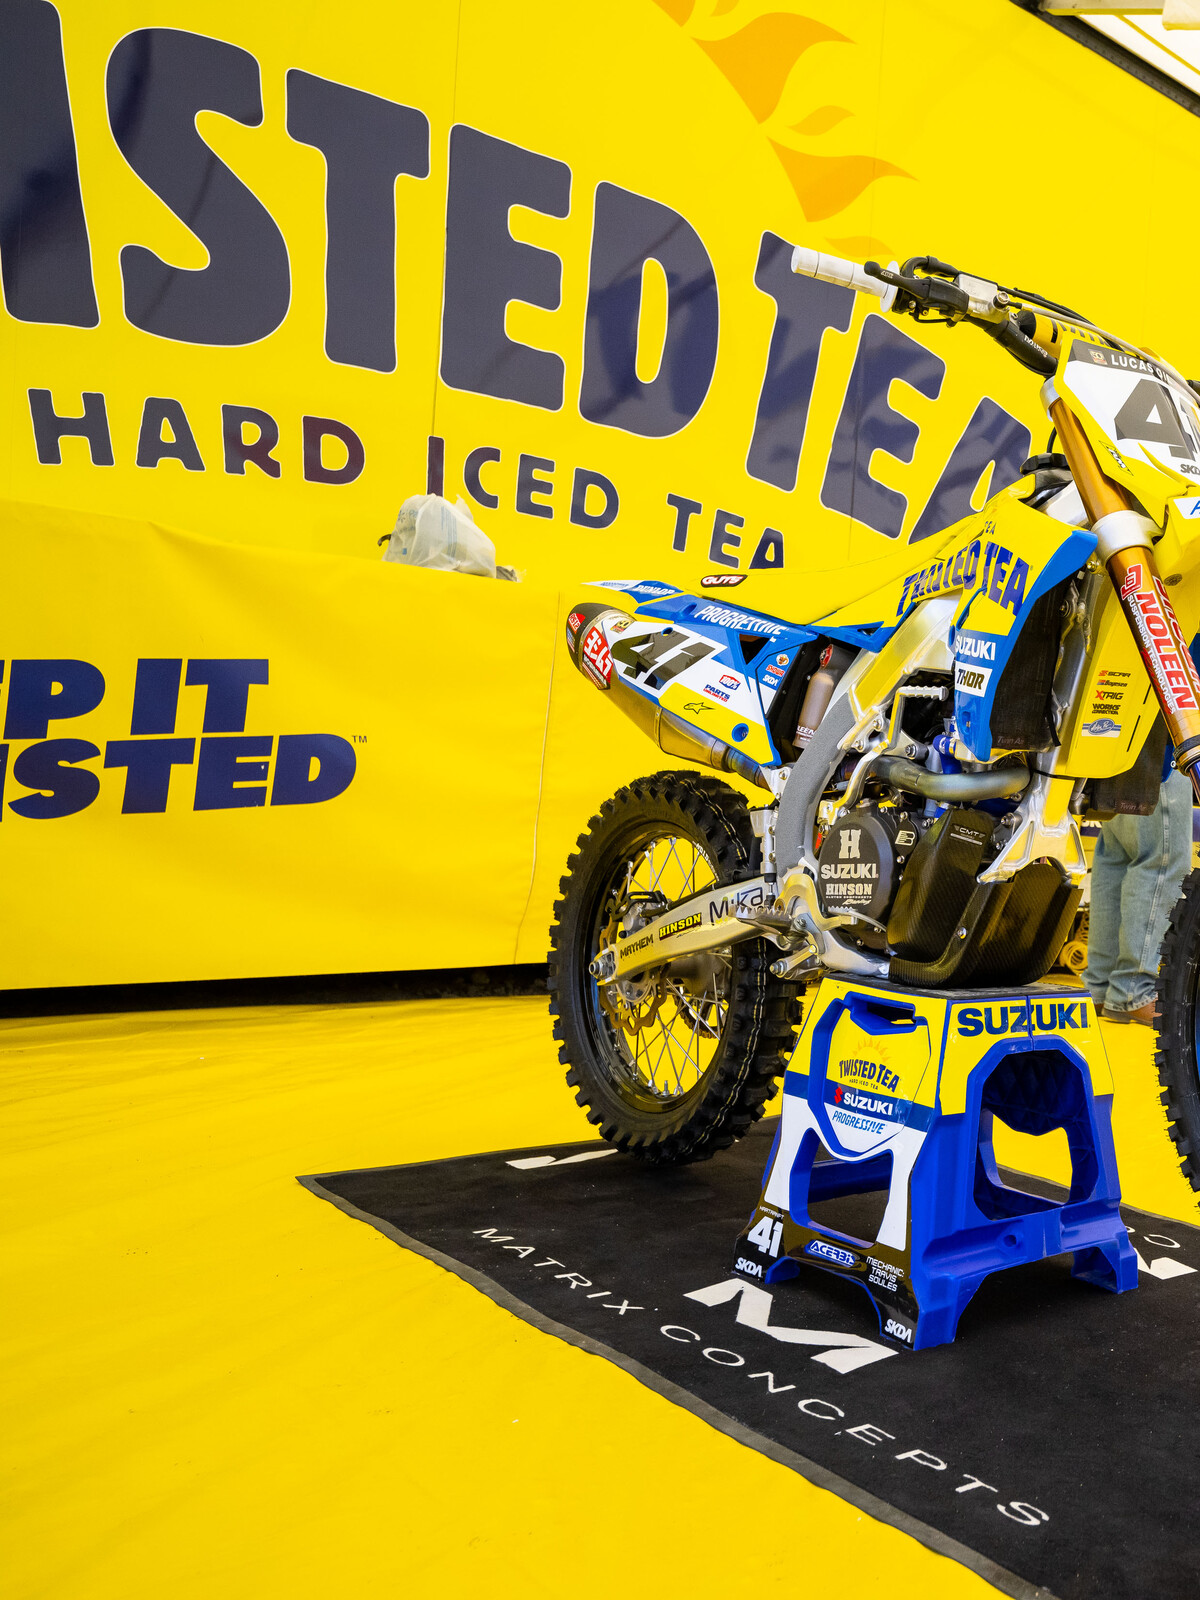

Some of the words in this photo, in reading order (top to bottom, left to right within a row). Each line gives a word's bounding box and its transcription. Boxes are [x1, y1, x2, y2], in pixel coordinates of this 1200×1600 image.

[1111, 354, 1153, 373] LUCAS
[745, 230, 1033, 544] TEA
[28, 388, 366, 486] HARD
[427, 436, 620, 530] ICED
[666, 493, 785, 570] TEA
[634, 584, 676, 596] DUNLOP
[701, 575, 744, 586] GUTS
[981, 541, 1030, 617] TEA
[1127, 594, 1150, 650] SUSPENSION
[611, 629, 716, 690] 41
[955, 634, 996, 661] SUZUKI
[1136, 589, 1199, 711] NOLEEN
[956, 667, 985, 690] THOR
[130, 658, 269, 735] IT
[704, 684, 730, 700] PARTS
[1095, 690, 1124, 700] XTRIG
[1092, 703, 1121, 711] WORKS
[0, 732, 357, 823] STED
[820, 863, 878, 879] SUZUKI
[825, 883, 873, 895] HINSON
[659, 913, 702, 938] HINSON
[619, 933, 654, 959] MAYHEM
[956, 1002, 1091, 1038] SUZUKI
[839, 1058, 877, 1080] TWISTED
[876, 1063, 900, 1093] TEA
[843, 1092, 894, 1116] SUZUKI
[832, 1110, 886, 1135] PROGRESSIVE
[747, 1215, 784, 1258] 41
[735, 1256, 764, 1279] SKDA
[865, 1255, 905, 1278] MECHANIC:
[871, 1266, 897, 1283] TRAVIS
[868, 1274, 898, 1292] SOULES
[884, 1318, 913, 1344] SKDA
[472, 1227, 646, 1316] MATRIX
[659, 1324, 1051, 1528] CONCEPTS
